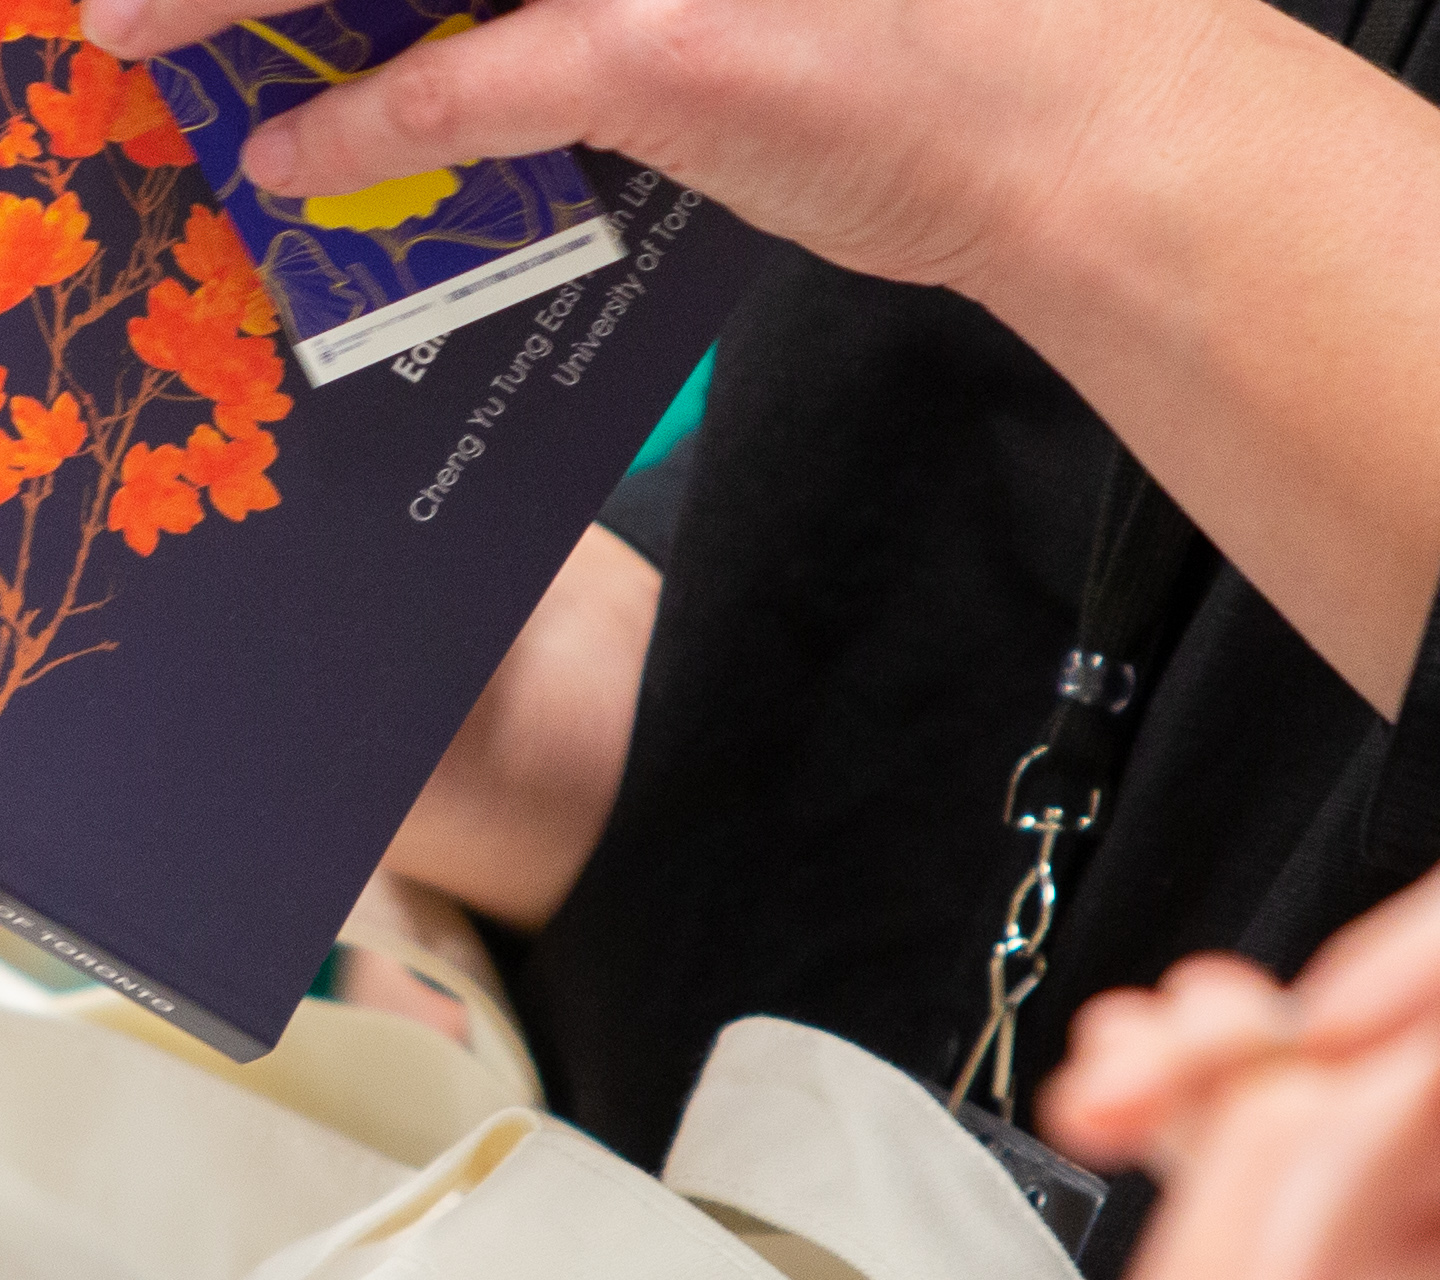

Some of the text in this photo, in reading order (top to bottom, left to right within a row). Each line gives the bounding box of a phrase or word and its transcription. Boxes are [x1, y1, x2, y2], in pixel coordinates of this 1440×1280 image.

[635, 239, 666, 272] of
[649, 189, 703, 241] Toro
[550, 272, 648, 387] University
[408, 433, 486, 522] Cheng
[466, 395, 507, 429] Yu
[489, 332, 555, 395] Tung
[39, 929, 176, 1013] TORONTO
